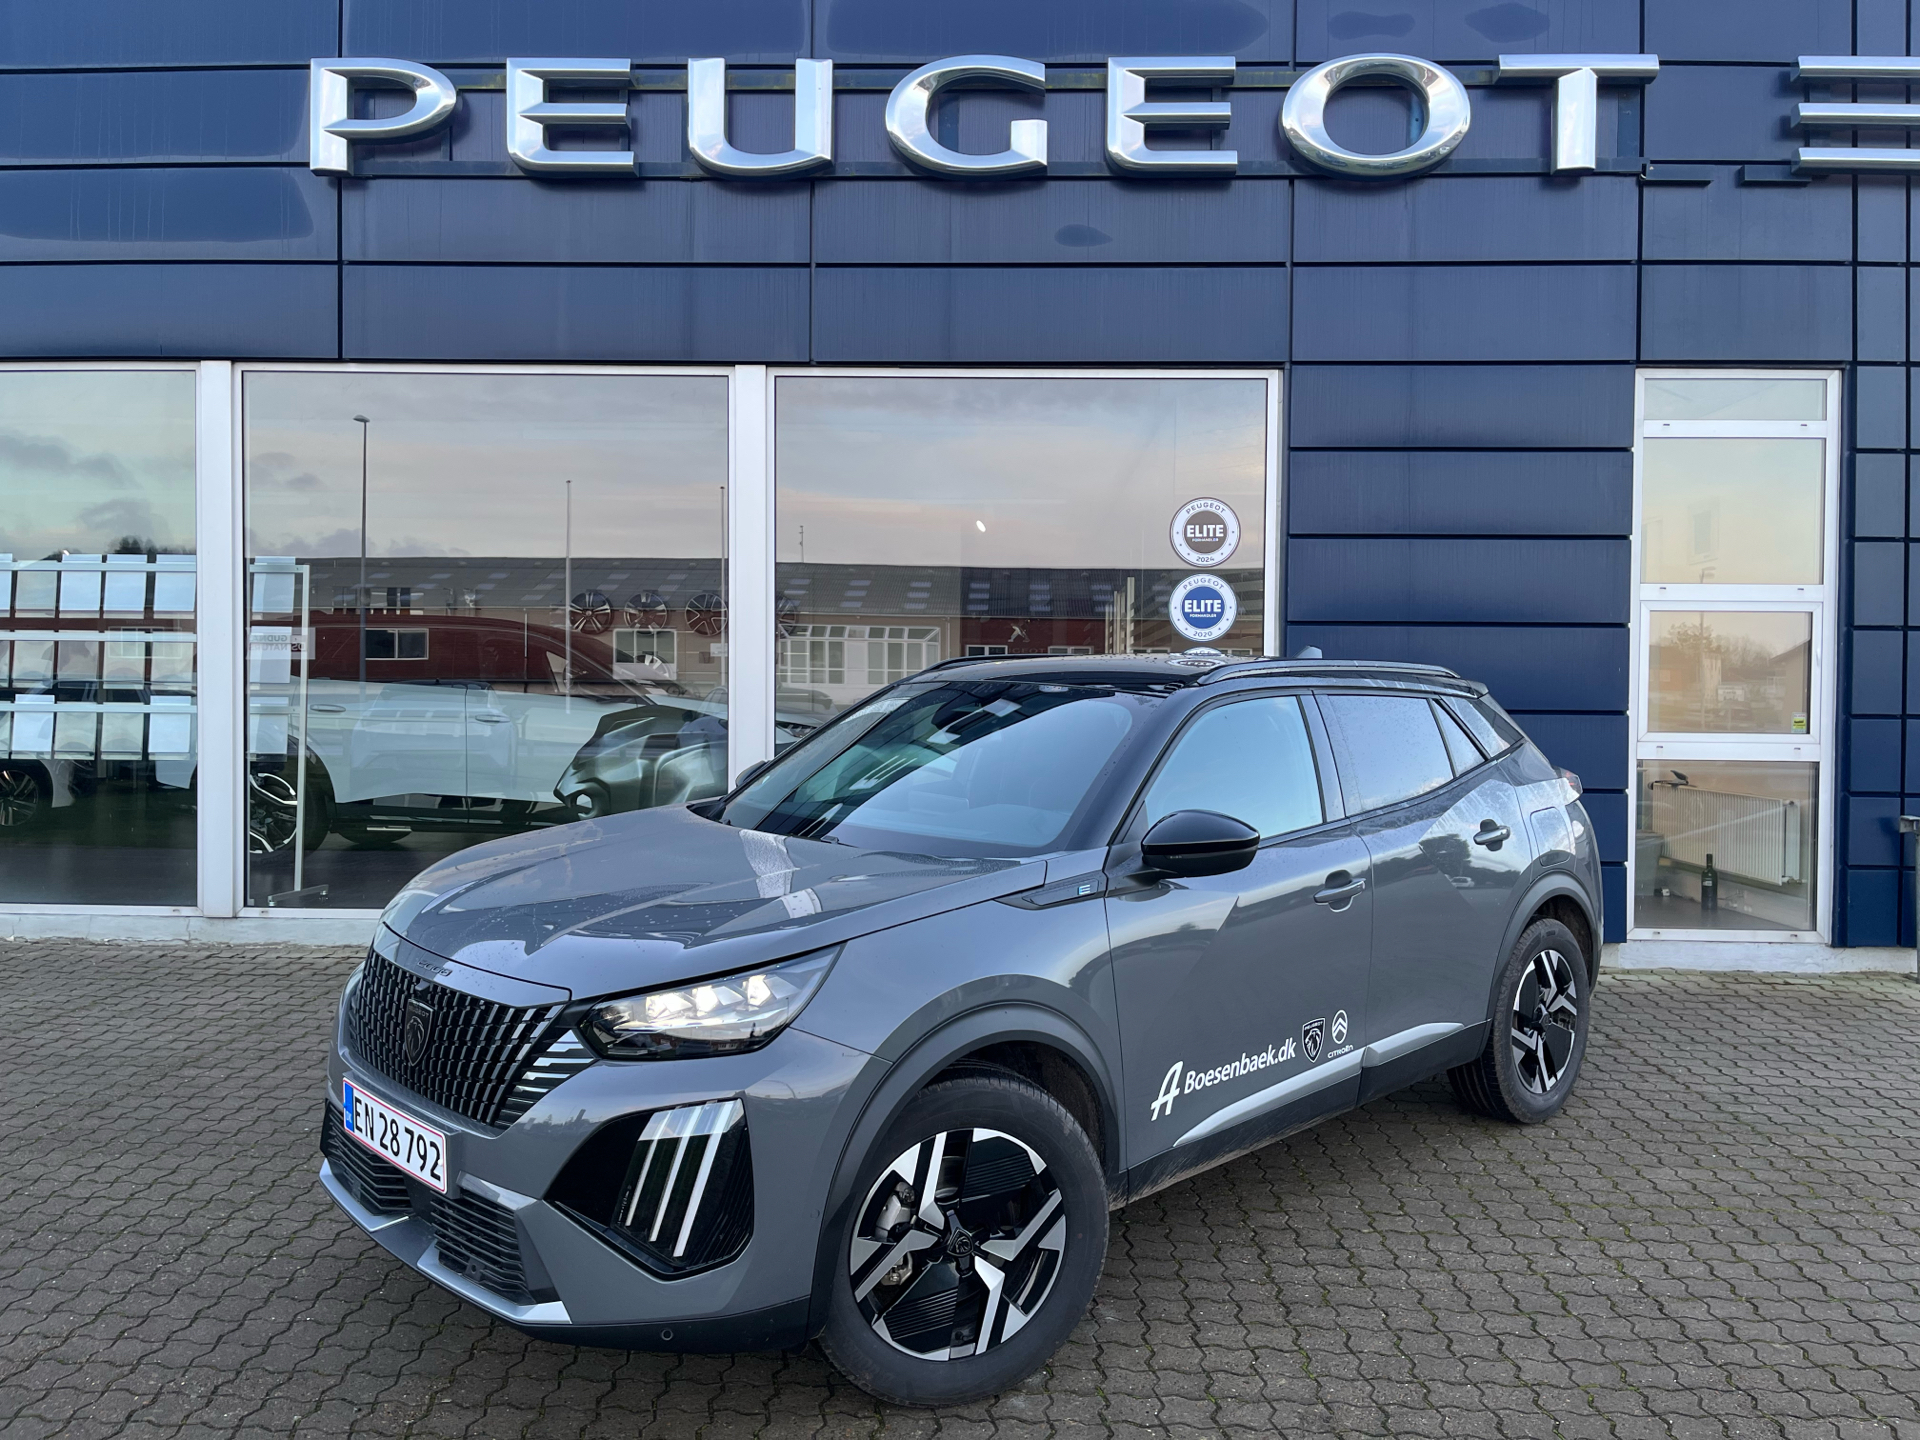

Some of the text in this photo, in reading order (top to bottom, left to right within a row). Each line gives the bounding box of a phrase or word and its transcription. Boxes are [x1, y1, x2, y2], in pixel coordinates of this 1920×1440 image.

[310, 53, 1660, 178] PEUGEOT
[1185, 502, 1226, 514] PEUGEOT
[1186, 525, 1224, 537] ELITE
[1182, 577, 1225, 590] PEUGEOT
[1184, 600, 1222, 612] ELITE
[1183, 1036, 1297, 1095] Boesenbaek.dk
[354, 1096, 441, 1182] EN 28 792
